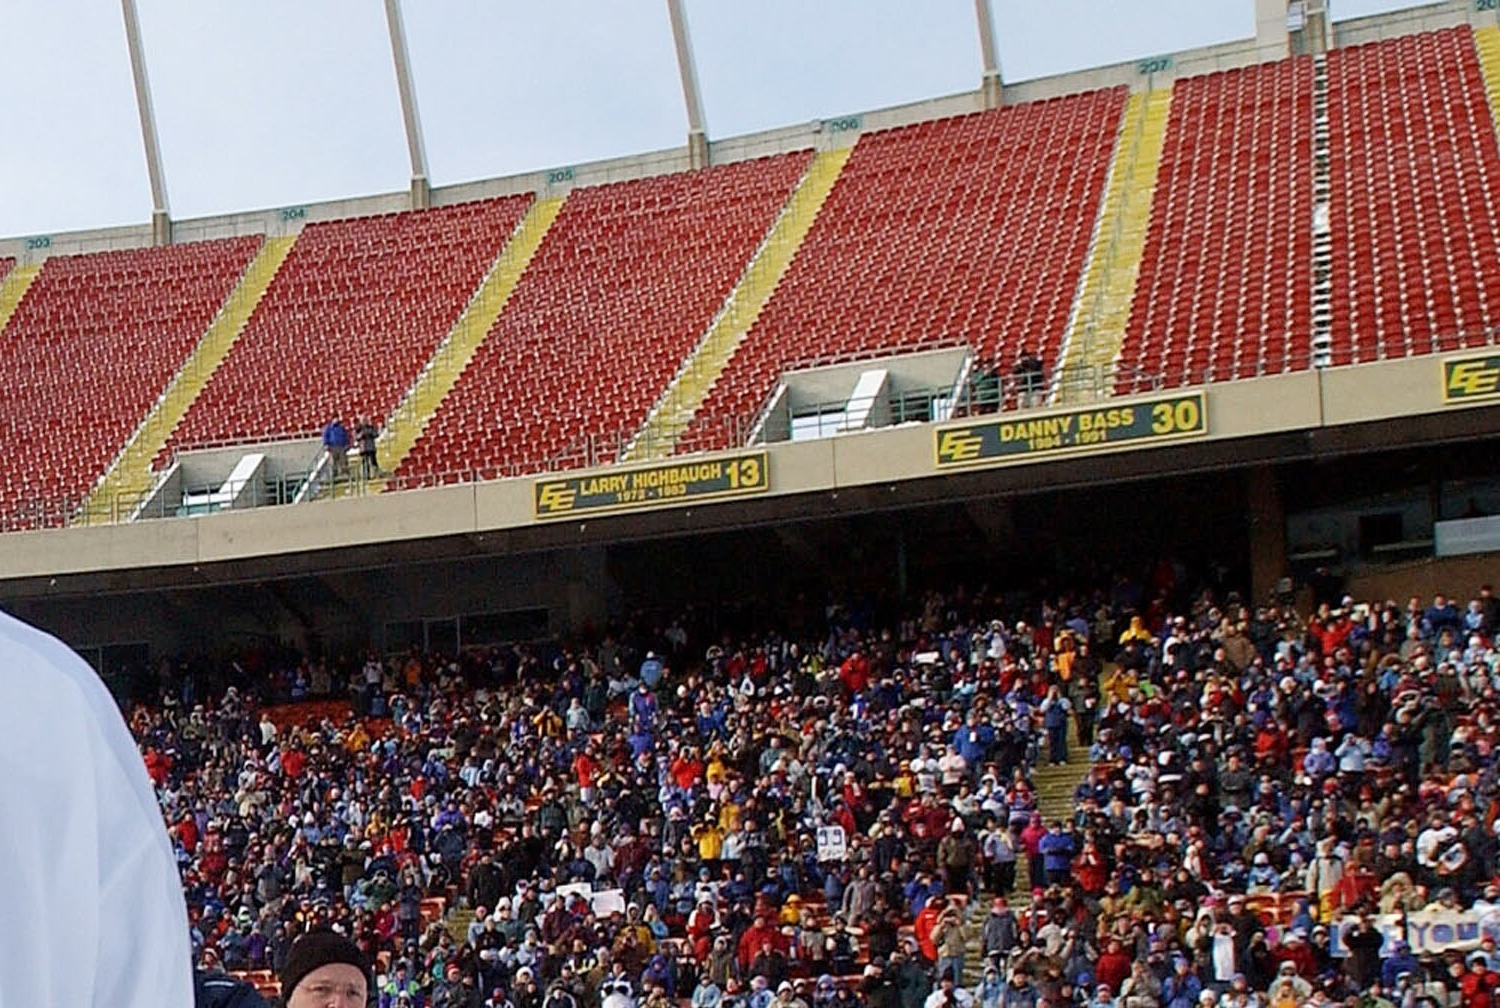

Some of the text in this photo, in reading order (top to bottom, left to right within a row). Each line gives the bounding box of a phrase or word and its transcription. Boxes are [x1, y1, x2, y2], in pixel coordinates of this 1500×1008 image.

[1000, 408, 1134, 443] DANNY BASS
[1152, 400, 1198, 434] 30
[580, 463, 721, 496] LARRY HIGHBAUGH
[726, 460, 759, 489] 13
